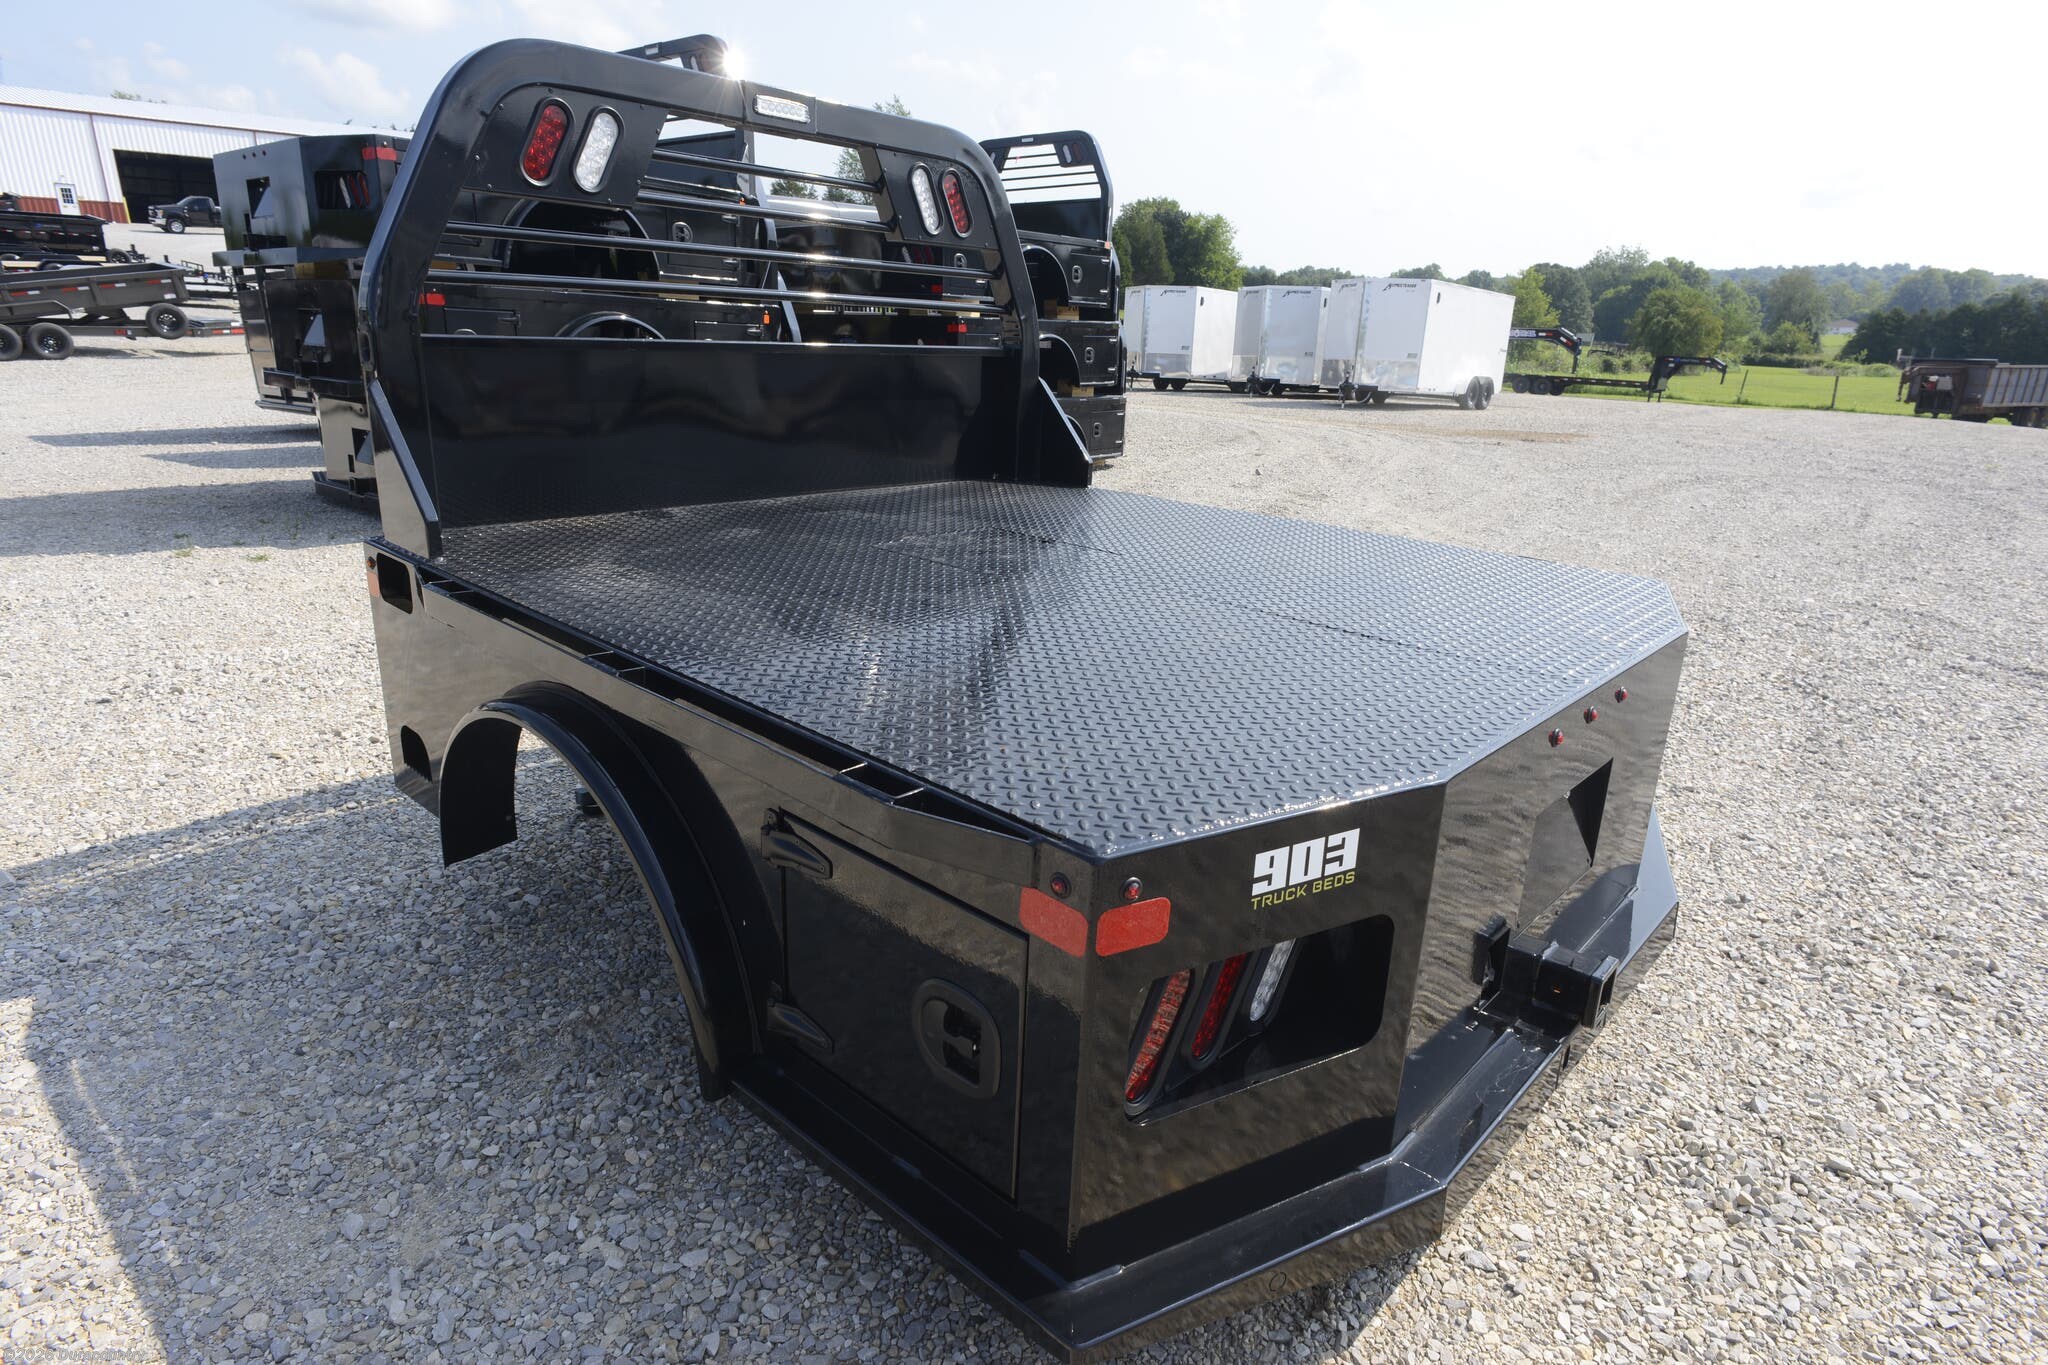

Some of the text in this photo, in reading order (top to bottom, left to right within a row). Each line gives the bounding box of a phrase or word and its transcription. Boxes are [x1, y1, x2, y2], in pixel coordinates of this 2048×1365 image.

[1251, 827, 1360, 897] 903
[1251, 871, 1356, 910] TRUCK BEDS
